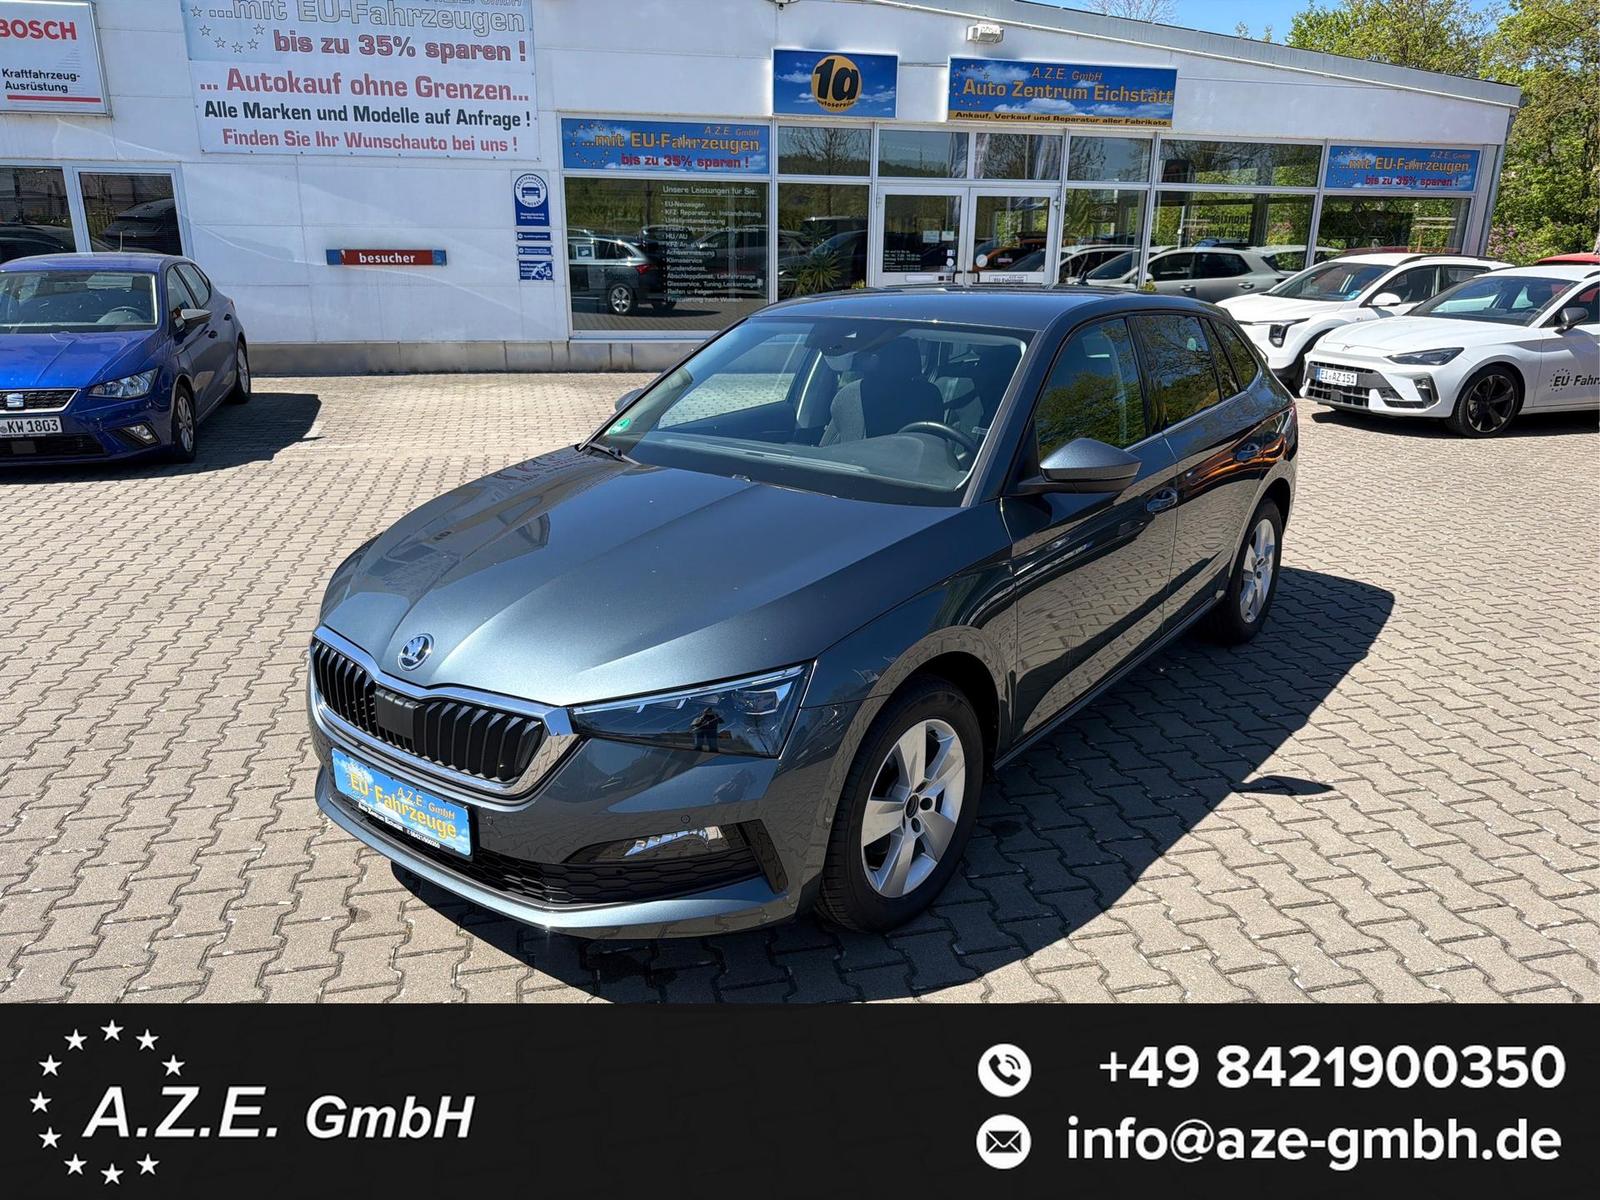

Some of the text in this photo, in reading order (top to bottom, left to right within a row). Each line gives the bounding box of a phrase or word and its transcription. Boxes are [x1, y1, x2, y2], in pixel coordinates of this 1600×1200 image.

[298, 0, 525, 37] EU-Fahrzeugen
[0, 19, 77, 40] BOSCH
[273, 29, 526, 64] bis zu 35% sparen !
[2, 68, 80, 82] Kraftfahrzeug-
[815, 59, 859, 101] 1a
[1071, 70, 1103, 81] GmbH
[5, 80, 68, 93] Ausrüstung
[226, 68, 342, 95] Autokauf
[350, 73, 408, 97] ohne
[415, 75, 529, 101] Grenzen...
[962, 78, 1006, 97] Auto
[1011, 80, 1088, 100] Zentrum
[204, 100, 531, 131] Alle Marken und Modelle auf Anfrage !
[955, 112, 991, 120] Ankauf,
[994, 113, 1031, 121] Verkauf
[1053, 115, 1100, 123] Reparatur
[1124, 118, 1168, 126] Fabrikate
[222, 128, 518, 152] Finden Sie Ihr Wunschauto bei uns !
[581, 132, 760, 155] ...mit EU-Fahrzeugen
[620, 153, 749, 170] bis zu 35% sparen !
[1375, 157, 1469, 175] EU-Fahrzeugen
[662, 185, 689, 194] Unsere
[691, 186, 730, 196] Leistungen
[1365, 176, 1379, 185] bis
[1382, 177, 1393, 185] zu
[1420, 177, 1453, 188] sparen
[1454, 176, 1459, 187] !
[358, 252, 416, 264] besucher
[1342, 373, 1355, 384] 151
[1553, 374, 1600, 387] EU-Fahr
[7, 419, 59, 433] KW 1803
[350, 772, 457, 839] EU-Fahrzeuge
[428, 801, 456, 820] GmbH
